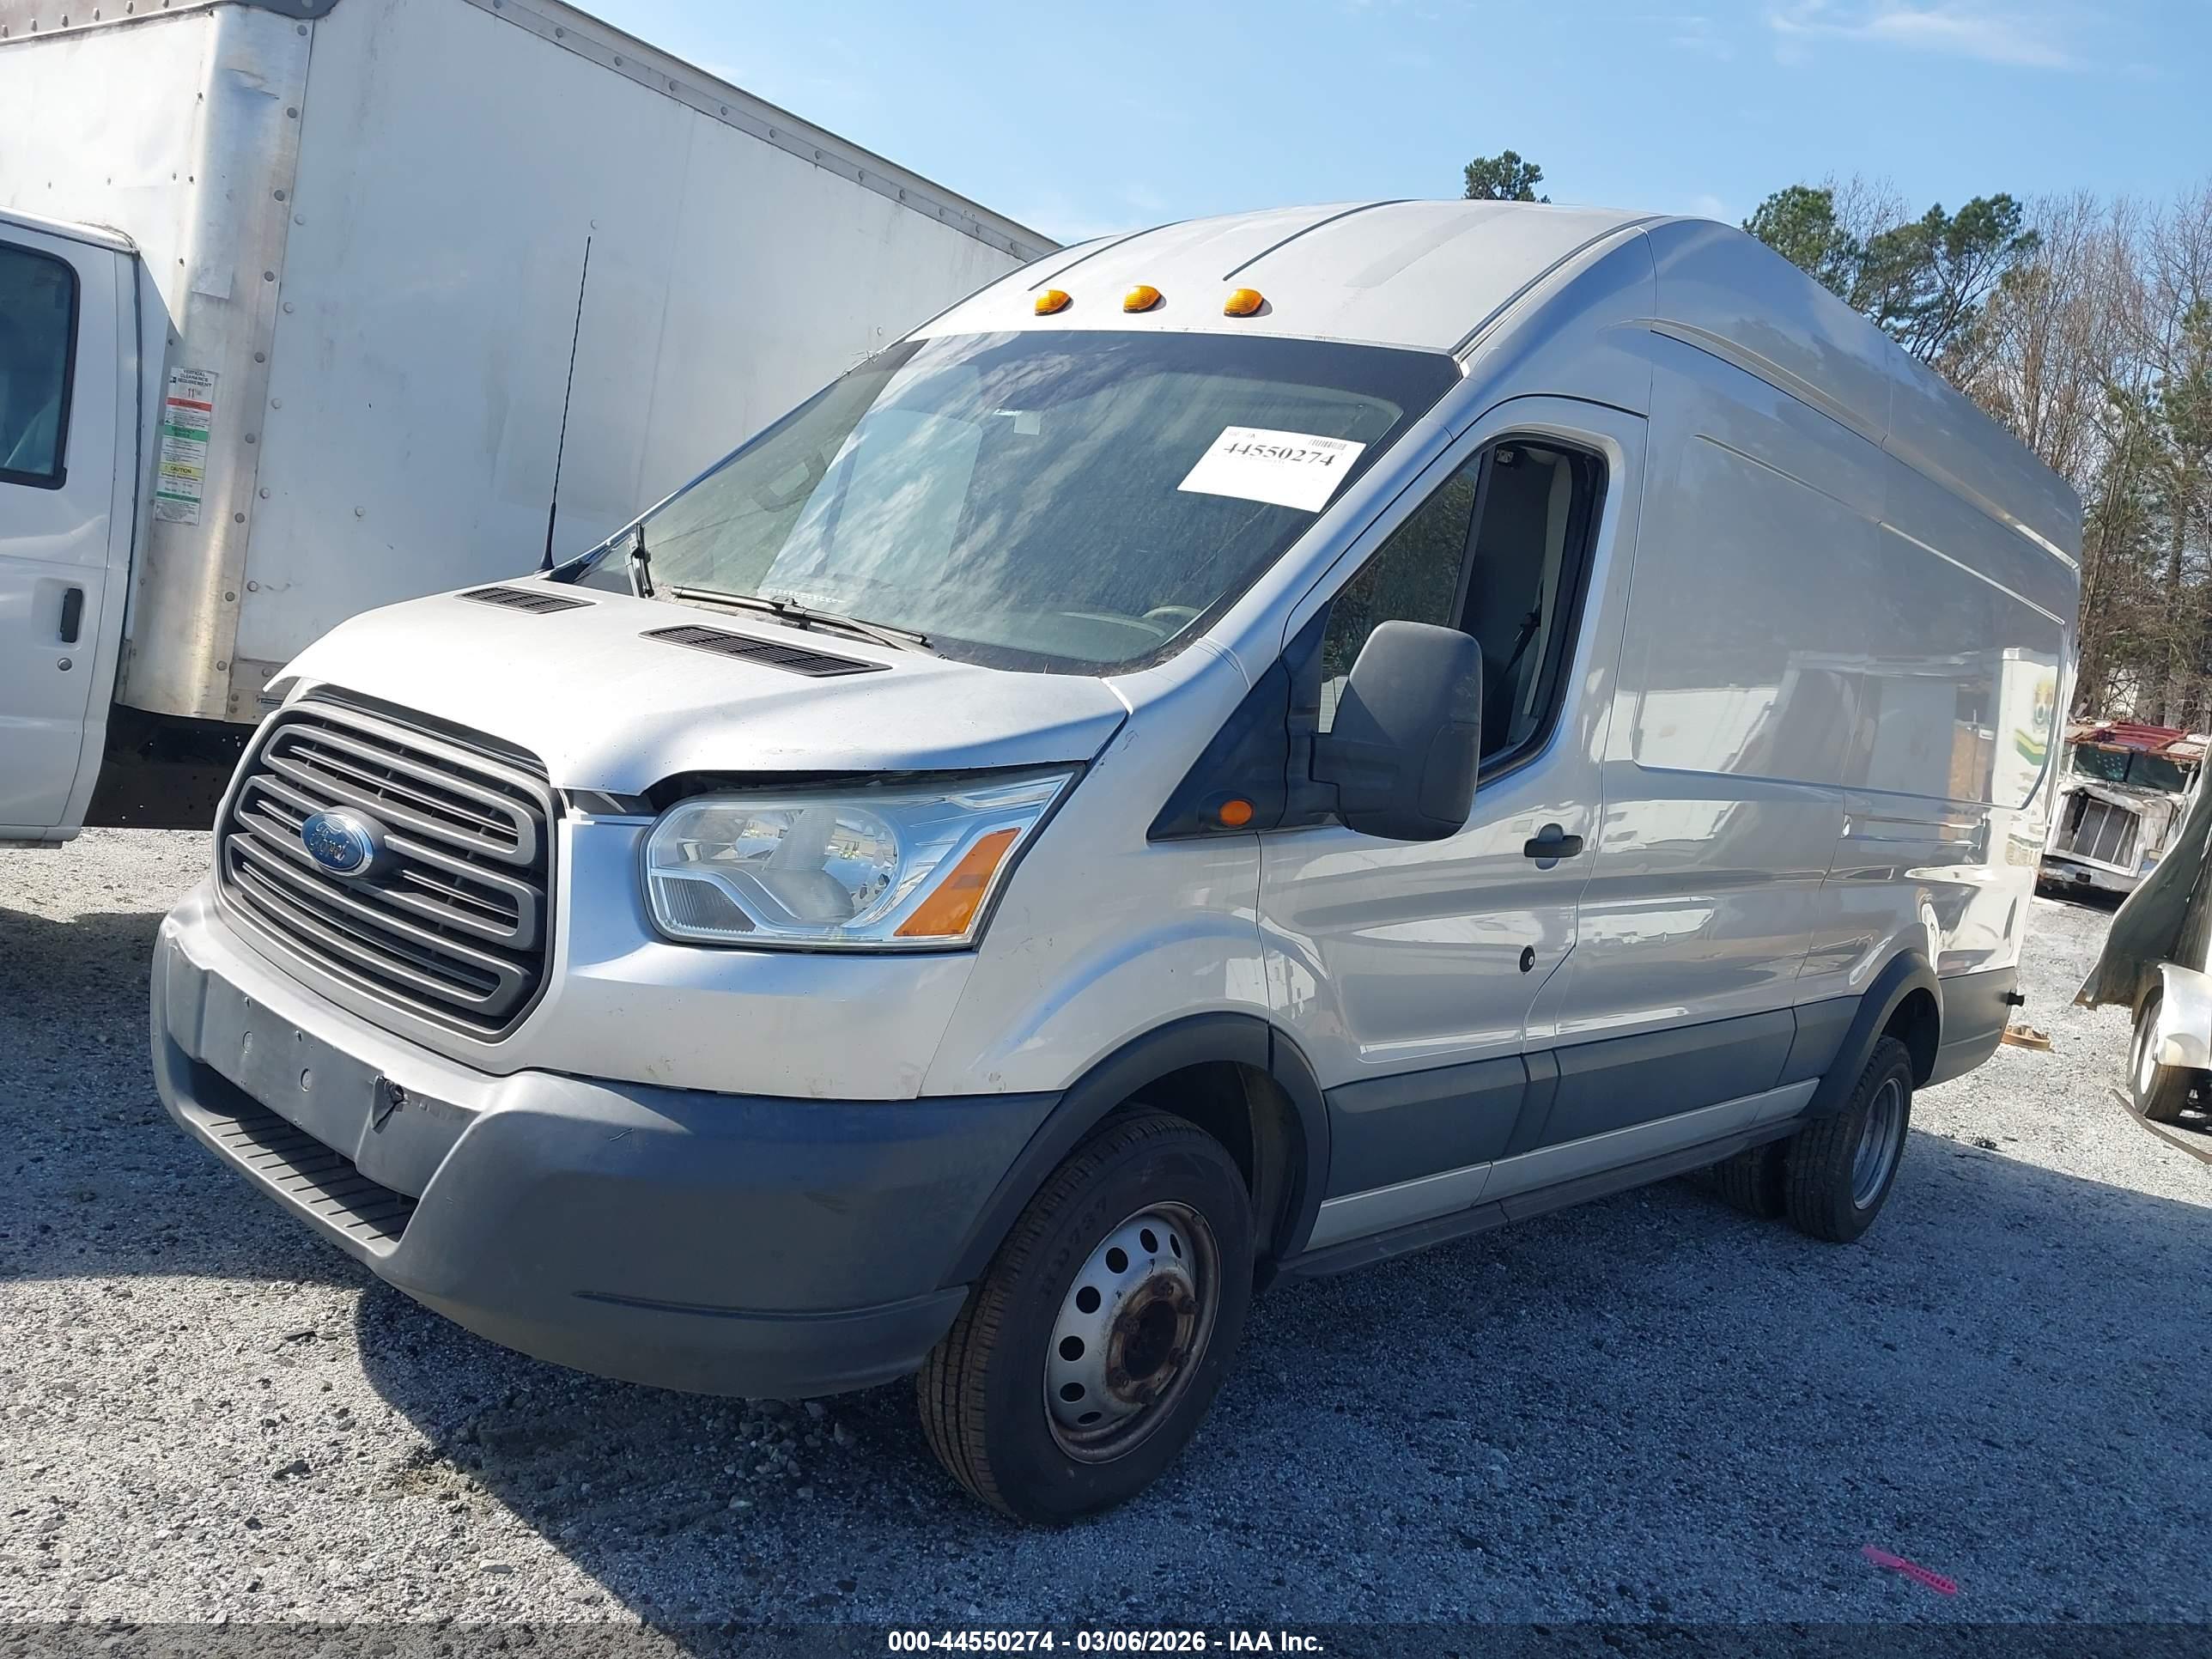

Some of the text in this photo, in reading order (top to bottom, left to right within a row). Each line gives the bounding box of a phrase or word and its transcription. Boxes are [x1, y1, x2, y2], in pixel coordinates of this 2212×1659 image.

[179, 373, 209, 382] CLEARANCE
[1224, 441, 1336, 467] 44550274
[170, 465, 192, 474] CAUTION
